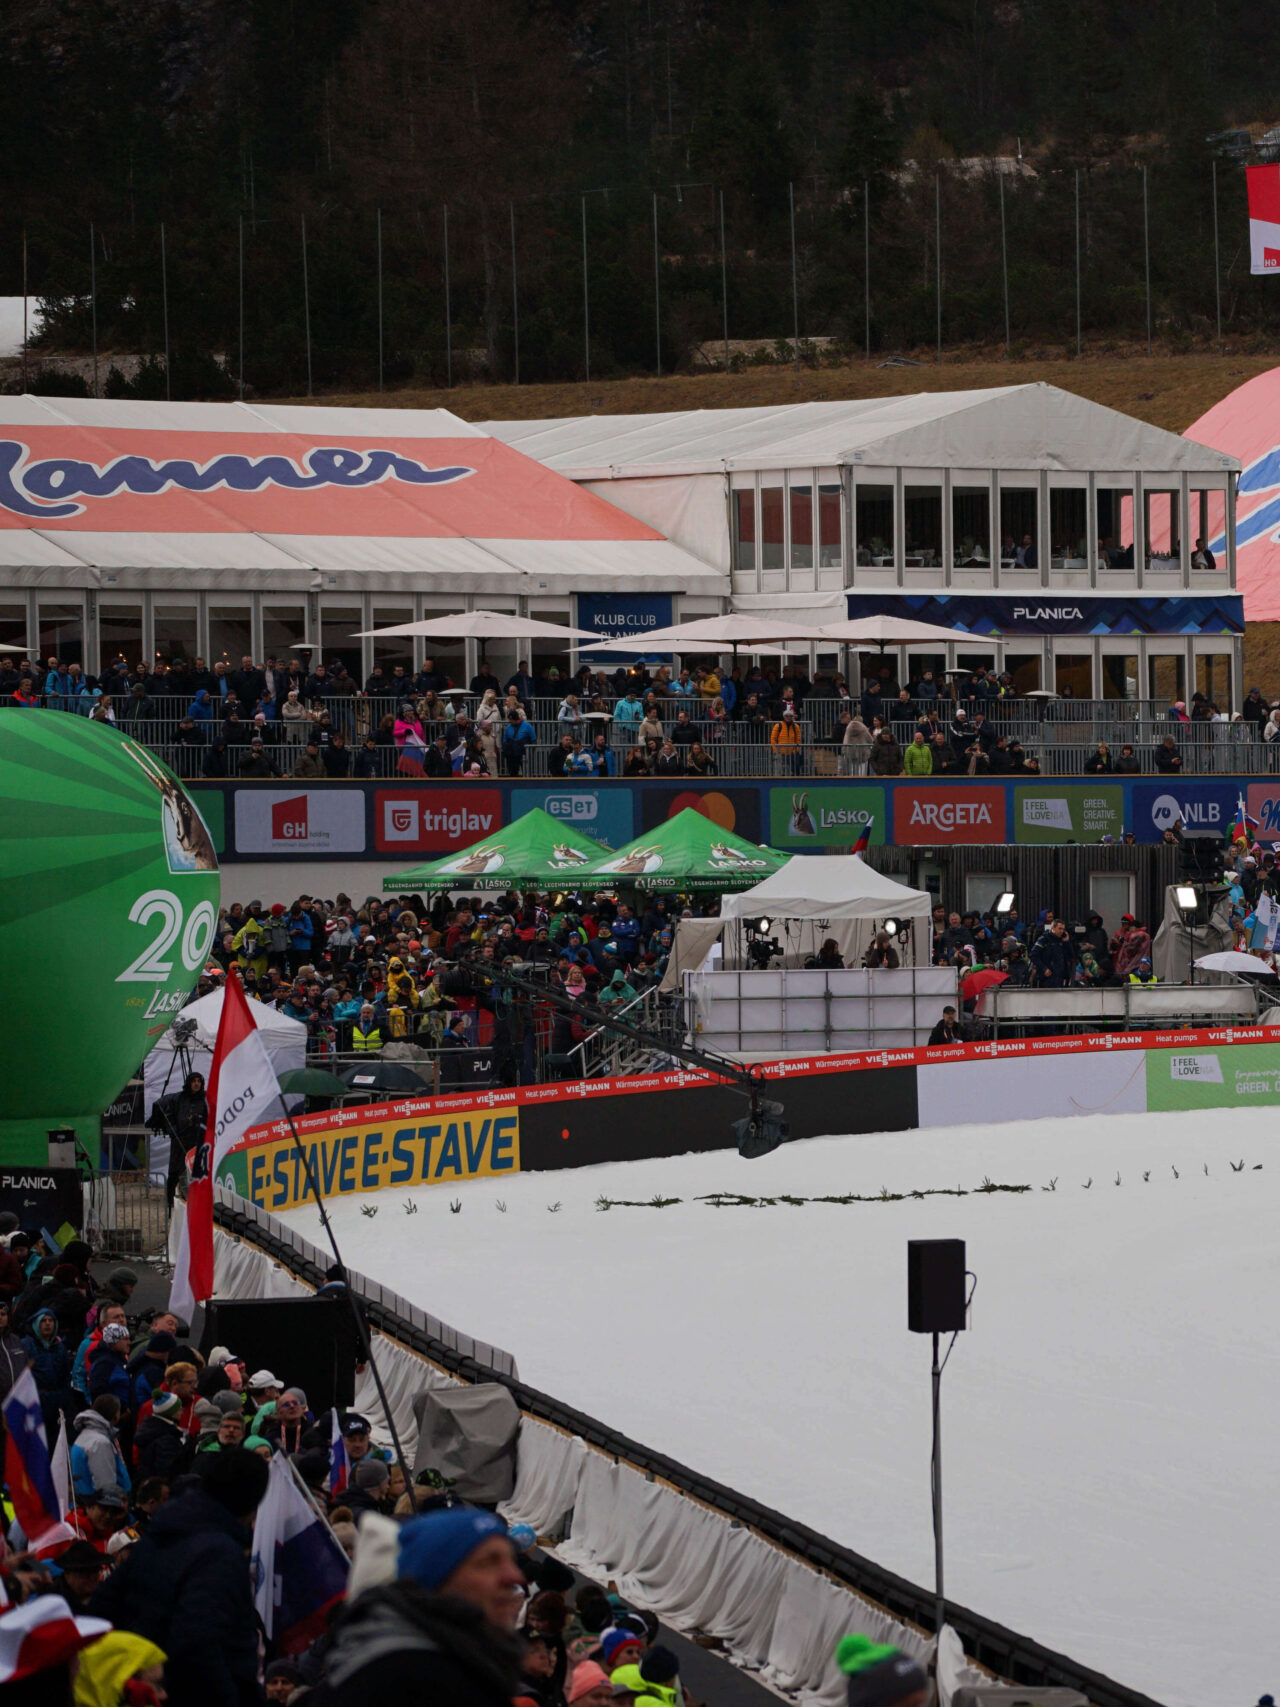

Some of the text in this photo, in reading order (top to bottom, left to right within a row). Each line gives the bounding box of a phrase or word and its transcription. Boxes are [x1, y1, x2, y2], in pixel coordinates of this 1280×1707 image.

[1013, 607, 1084, 620] PLANICA
[594, 614, 656, 626] KLUB CLUB
[1030, 802, 1049, 810] FEEL
[1084, 800, 1109, 808] GREEN.
[820, 808, 869, 828] LAŠKO
[1084, 810, 1118, 819] CREATIVE.
[1184, 803, 1221, 823] NLB
[424, 808, 493, 834] triglav
[1084, 821, 1109, 830] SMART.
[283, 822, 306, 837] GH
[815, 1058, 861, 1068] Wärmepumpen
[866, 1052, 915, 1066] VIESSMANN
[926, 1049, 941, 1058] Heat
[944, 1048, 965, 1059] pumps
[974, 1042, 1026, 1056] VIESSMANN
[1033, 1038, 1083, 1050] Wärmepumpen
[1089, 1035, 1142, 1049] VIESSMANN
[1156, 1034, 1172, 1043] Heat
[1174, 1034, 1198, 1044] pumps
[1208, 1029, 1264, 1043] VIESSMANN
[474, 1060, 491, 1072] PLA
[1178, 1058, 1198, 1067] FEEL
[526, 1090, 538, 1099] Heat
[540, 1088, 558, 1099] pumps
[1236, 1081, 1272, 1095] GREEN.
[2, 1176, 57, 1190] PLANICA
